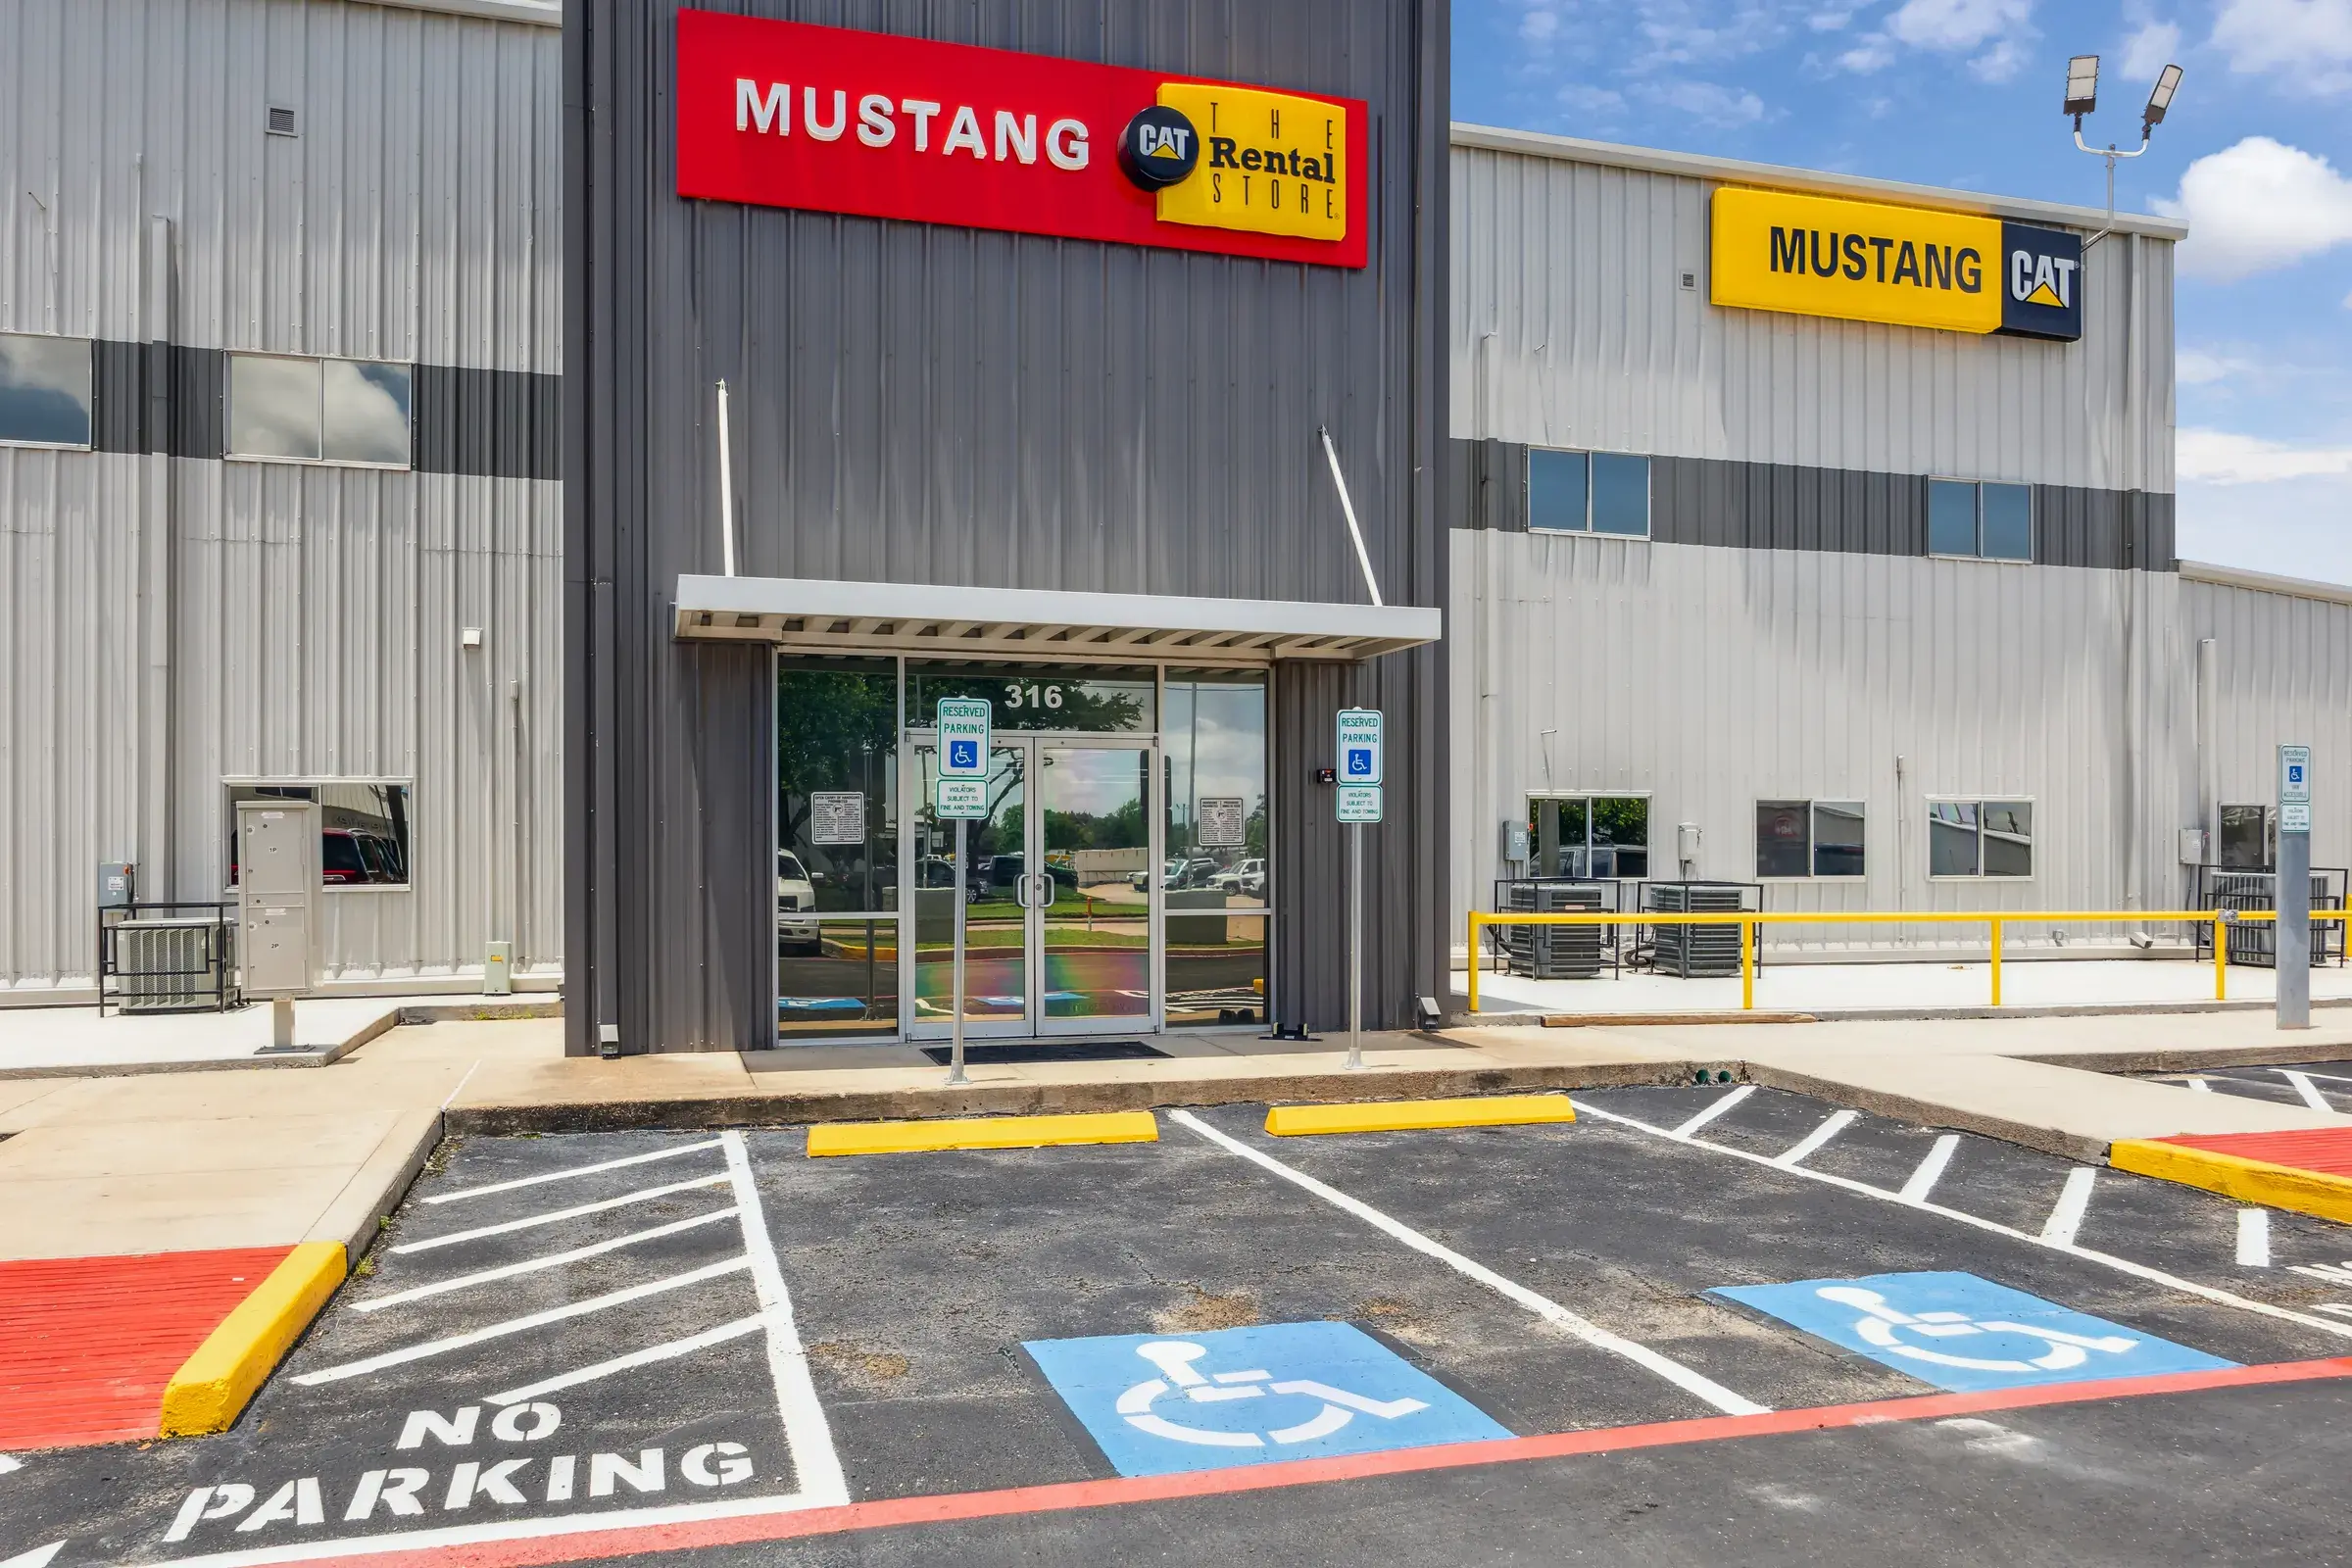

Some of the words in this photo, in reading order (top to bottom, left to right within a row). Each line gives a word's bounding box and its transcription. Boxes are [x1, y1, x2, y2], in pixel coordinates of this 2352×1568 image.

[736, 78, 1090, 172] MUSTANG
[1139, 123, 1189, 161] CAT
[1210, 102, 1333, 149] THE
[1208, 136, 1336, 184] Rental
[1213, 173, 1334, 220] STORE
[1770, 225, 1982, 294] MUSTANG
[2011, 250, 2075, 309] CAT
[943, 707, 985, 717] RESERVED
[1004, 684, 1062, 709] 316
[944, 723, 985, 734] PARKING
[1342, 717, 1378, 727] RESERVED
[1343, 734, 1377, 743] PARKING
[396, 1401, 563, 1449] NO
[163, 1441, 755, 1544] PARKING
